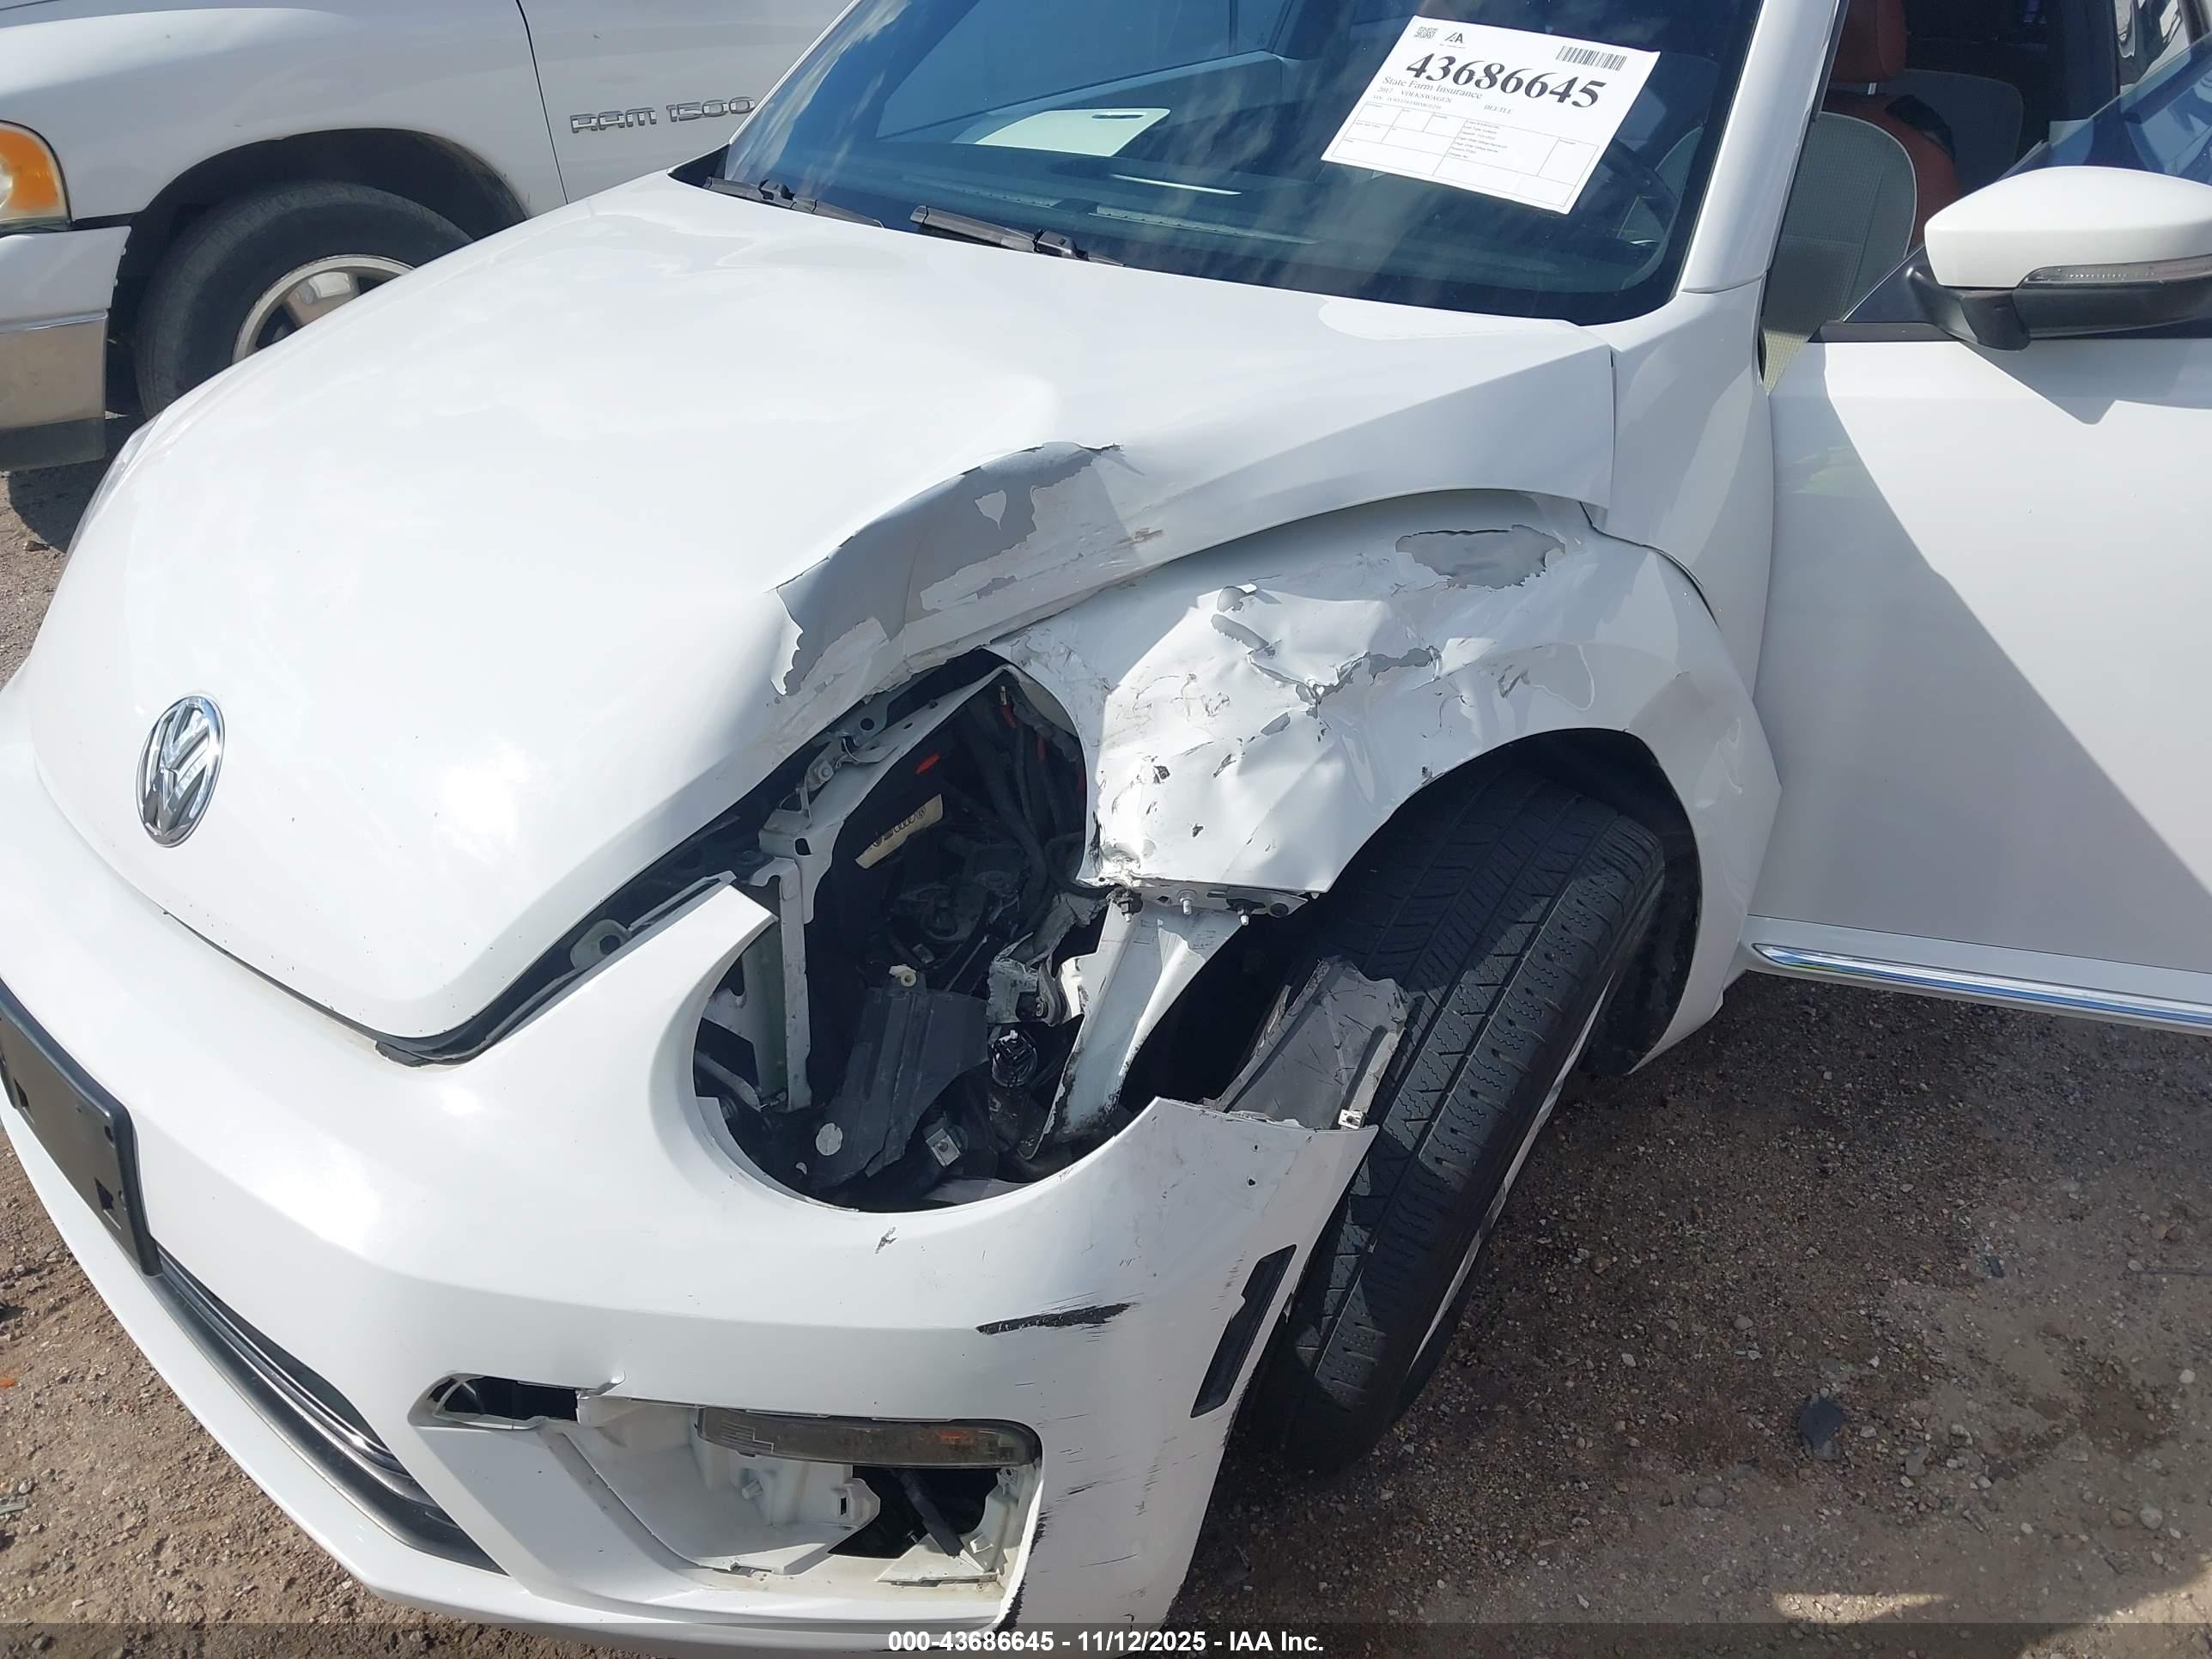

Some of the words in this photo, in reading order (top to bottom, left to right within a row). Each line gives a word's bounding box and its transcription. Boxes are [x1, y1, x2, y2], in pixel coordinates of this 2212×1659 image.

[1382, 76, 1407, 88] State
[1408, 80, 1434, 91] Farm
[1436, 85, 1483, 100] Insurance
[1406, 53, 1607, 108] 43686645
[1401, 90, 1453, 103] VOLKSWAGEN
[570, 106, 657, 134] RAM
[666, 96, 756, 123] 1500
